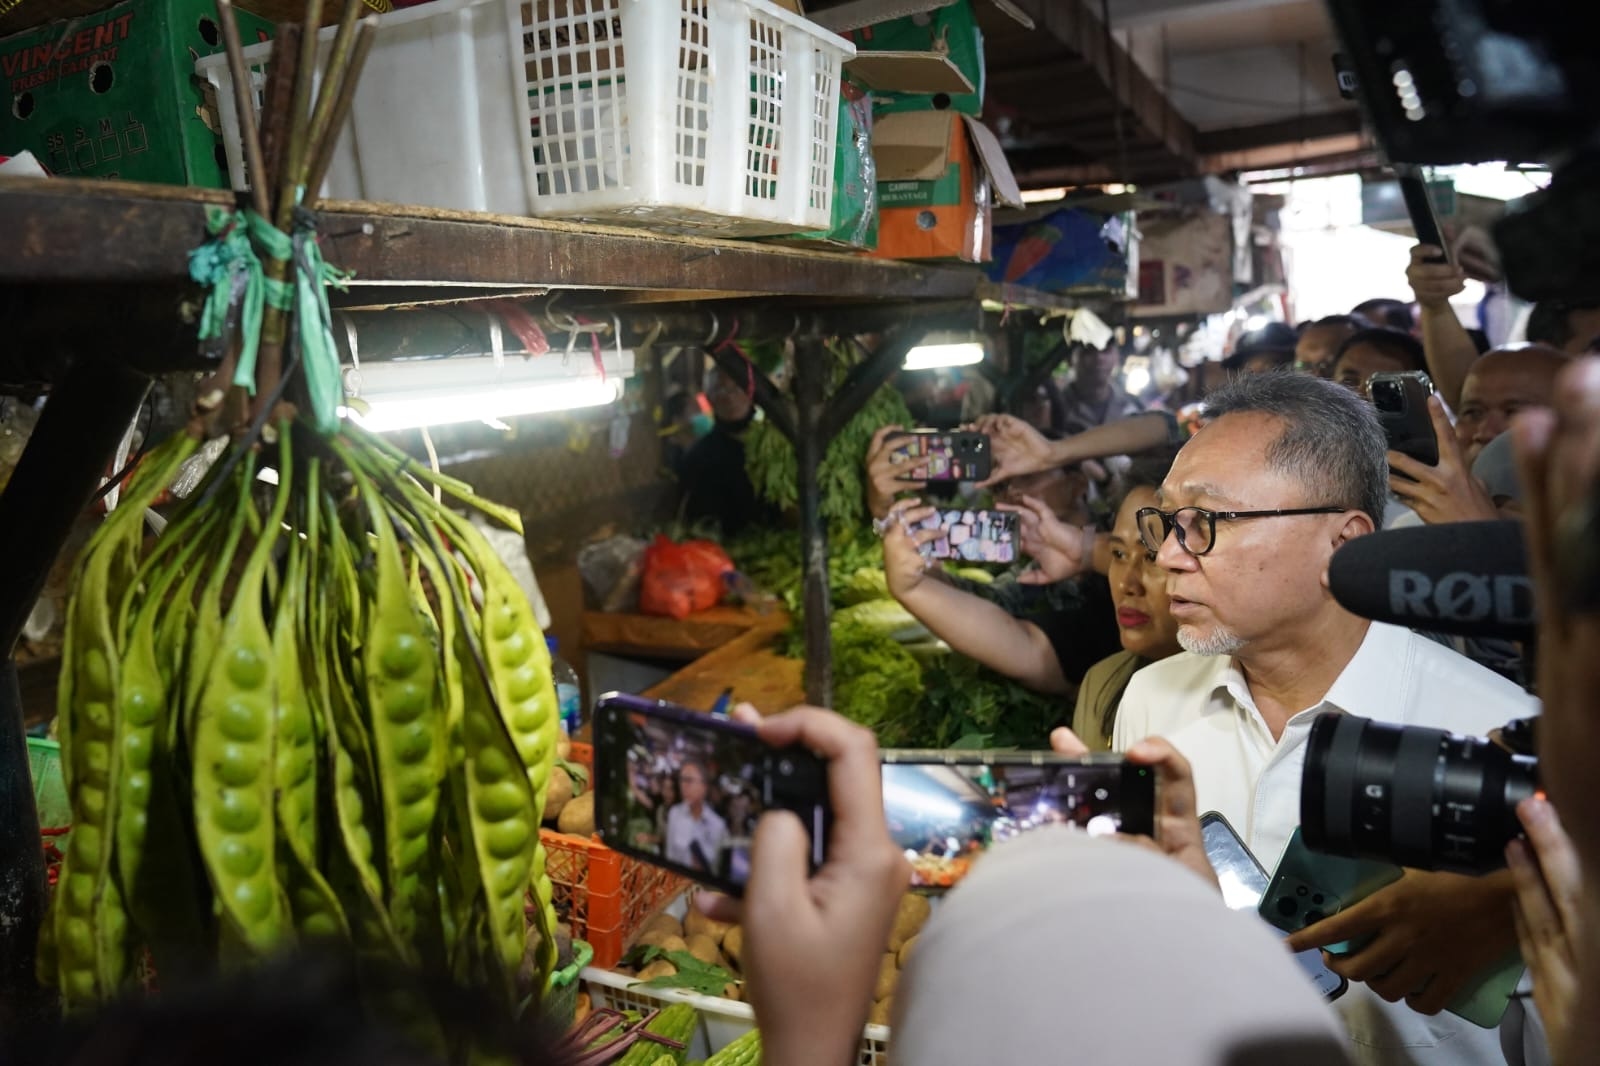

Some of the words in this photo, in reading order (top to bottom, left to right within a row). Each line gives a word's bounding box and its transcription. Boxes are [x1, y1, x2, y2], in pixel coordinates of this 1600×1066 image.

[2, 12, 134, 78] VINCENT
[47, 133, 65, 148] SS
[75, 127, 85, 140] S
[98, 119, 112, 132] M
